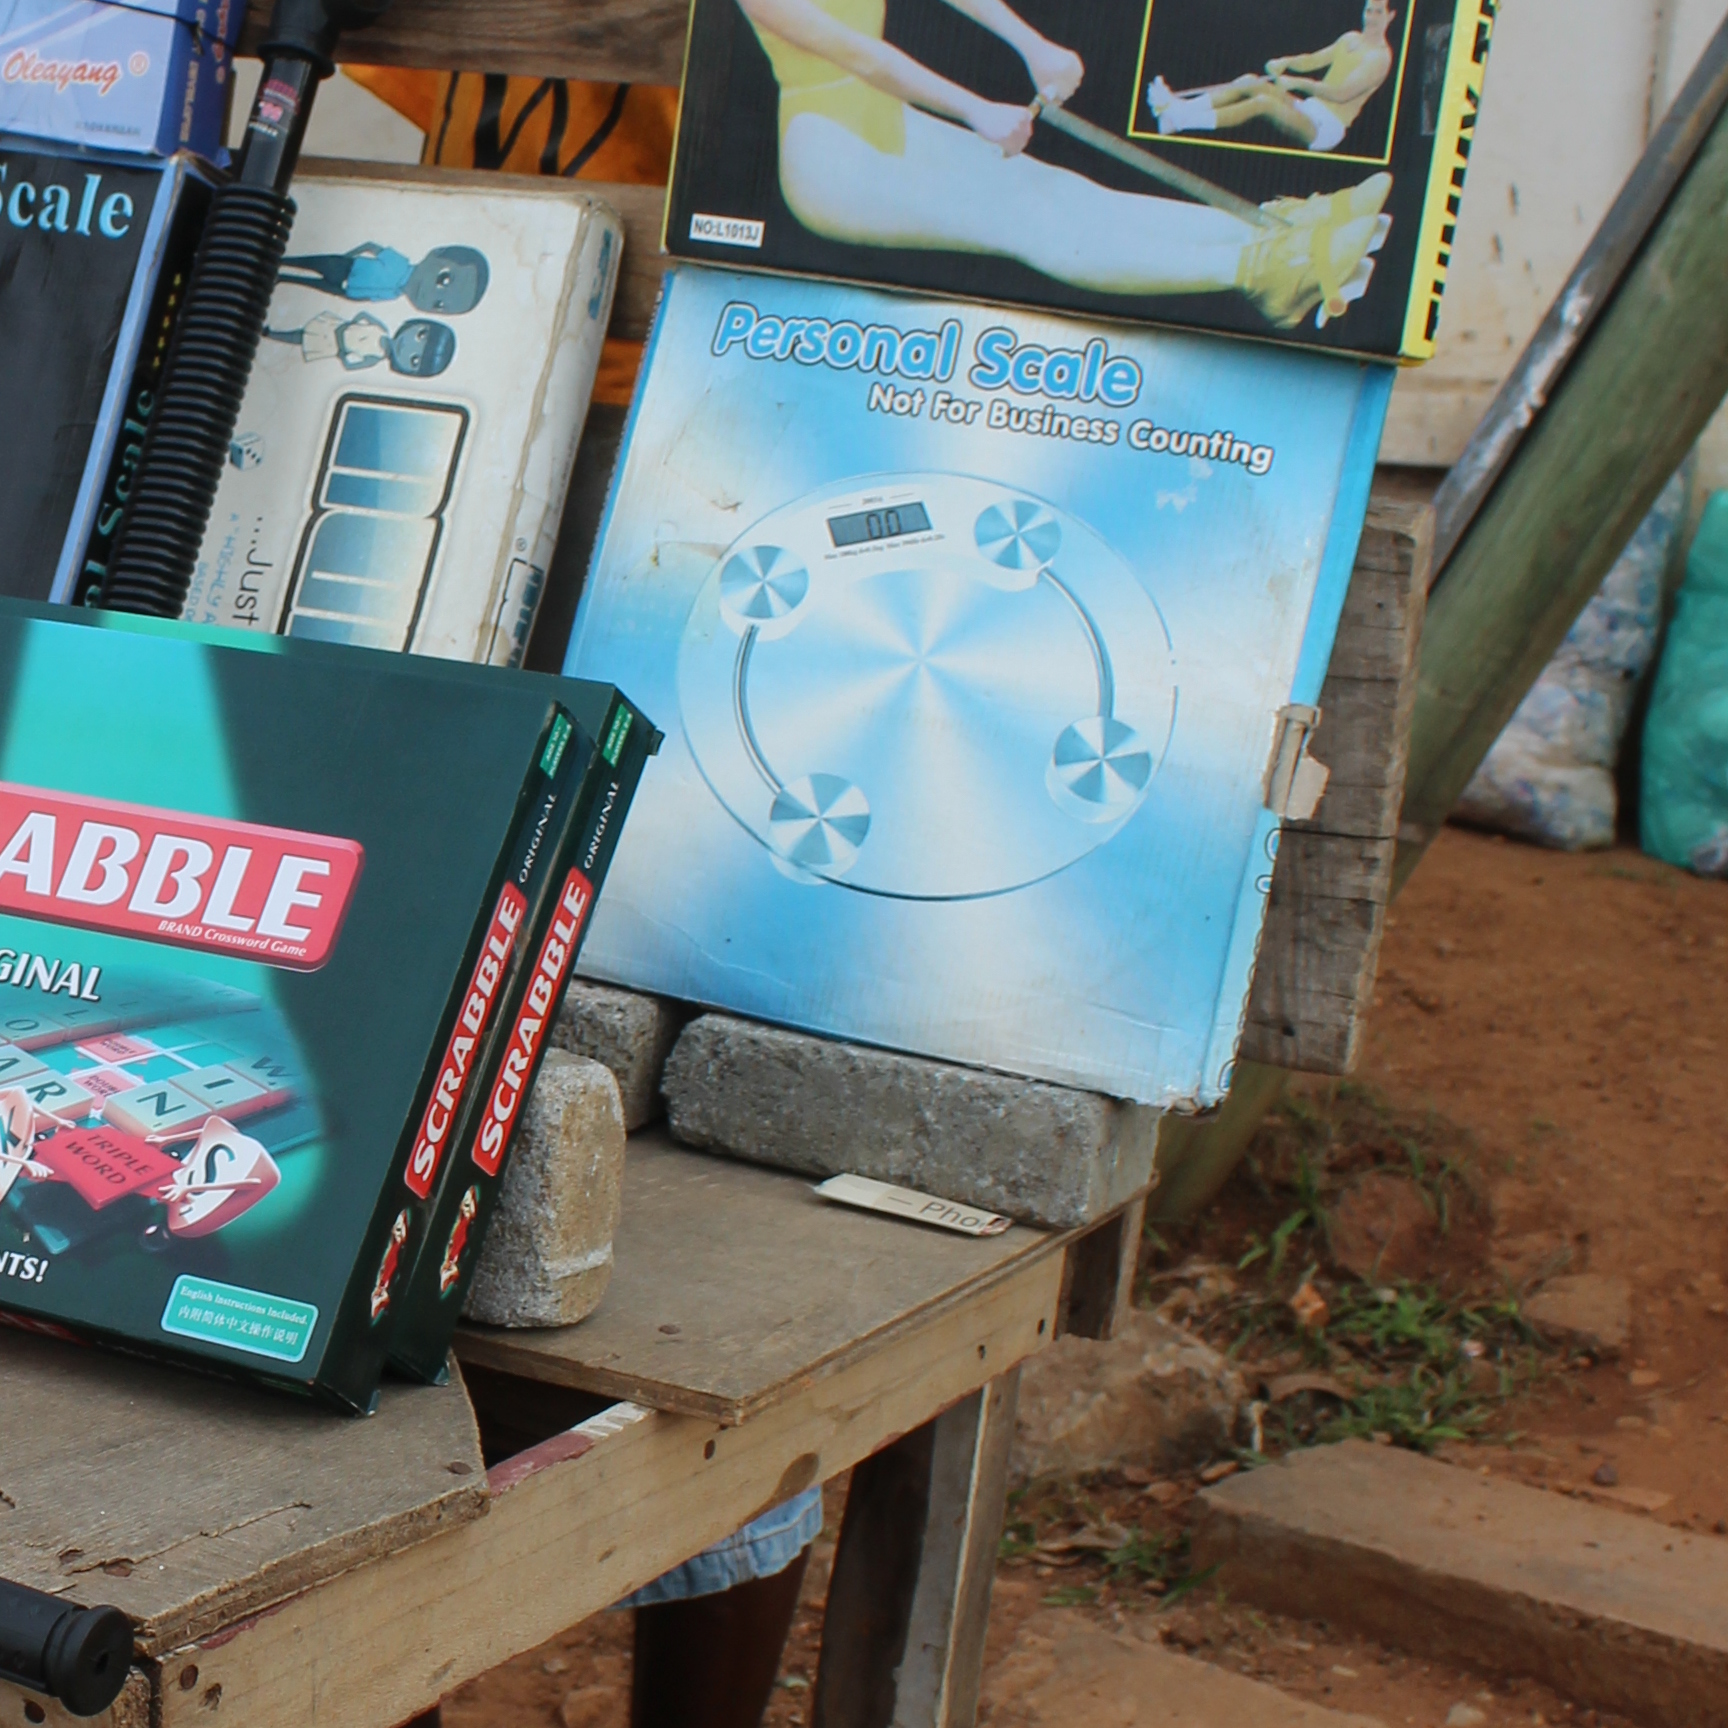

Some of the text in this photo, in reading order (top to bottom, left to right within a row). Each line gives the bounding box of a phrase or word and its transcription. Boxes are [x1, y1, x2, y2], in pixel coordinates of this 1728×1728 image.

[3, 50, 118, 95] Oleayang
[712, 301, 1142, 407] Personal Scale
[869, 383, 1274, 475] Not For Business Counting
[519, 793, 558, 885] ORIGINAL
[584, 782, 620, 870] ORIGINAL
[158, 919, 307, 959] BRAND Crossword Game
[413, 896, 521, 1181] SCRABBLE
[481, 881, 586, 1159] SCRABBLE
[65, 1141, 127, 1186] WORD
[87, 1133, 150, 1176] TRIPLE
[180, 1285, 308, 1325] English Instructions Included.
